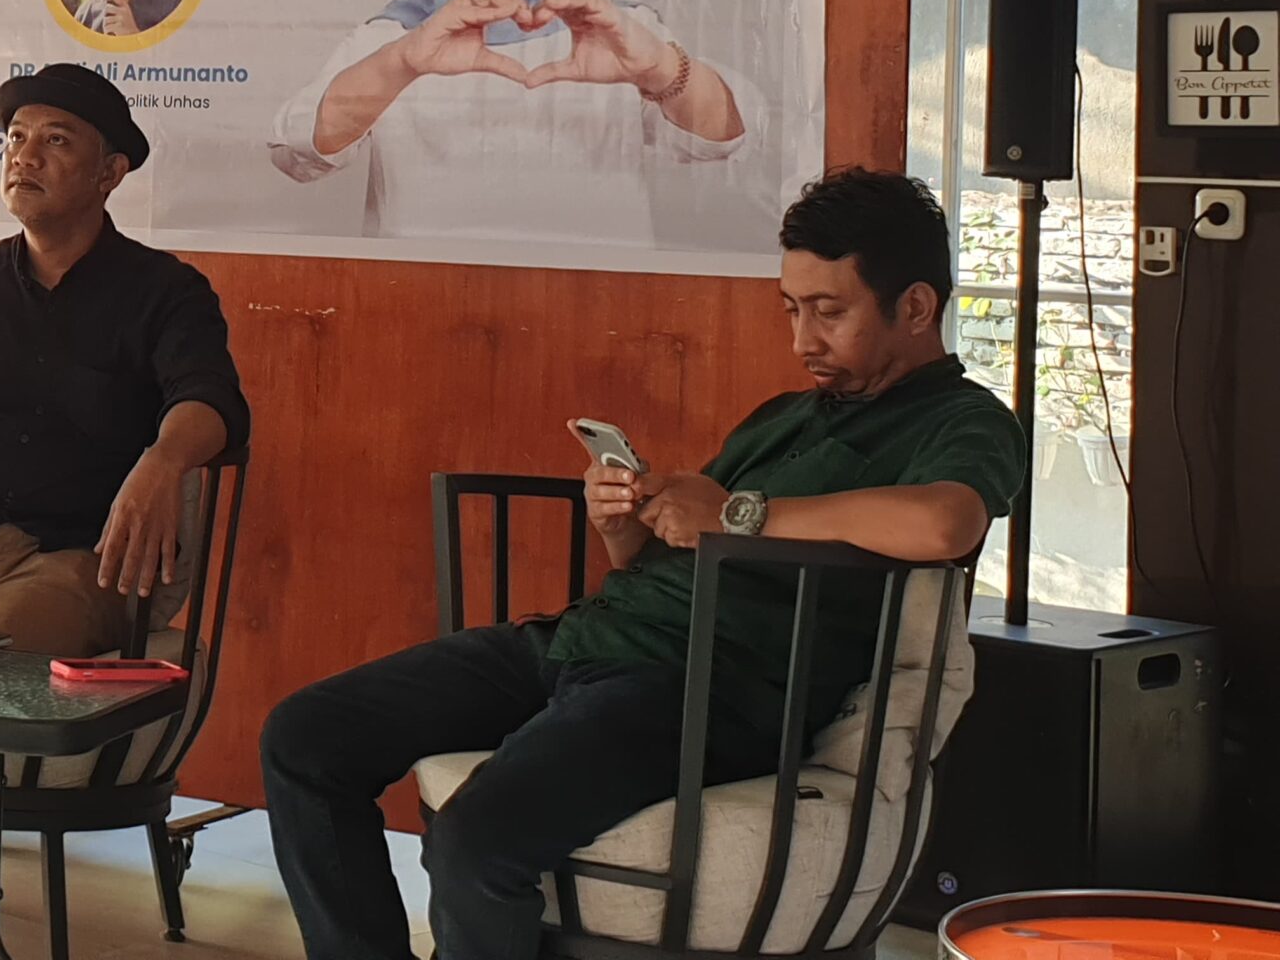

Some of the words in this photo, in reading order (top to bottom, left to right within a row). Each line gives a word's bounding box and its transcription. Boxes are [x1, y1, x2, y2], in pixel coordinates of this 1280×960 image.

[122, 63, 249, 83] Armunanto
[124, 94, 159, 109] olitik
[163, 95, 210, 109] Unhas
